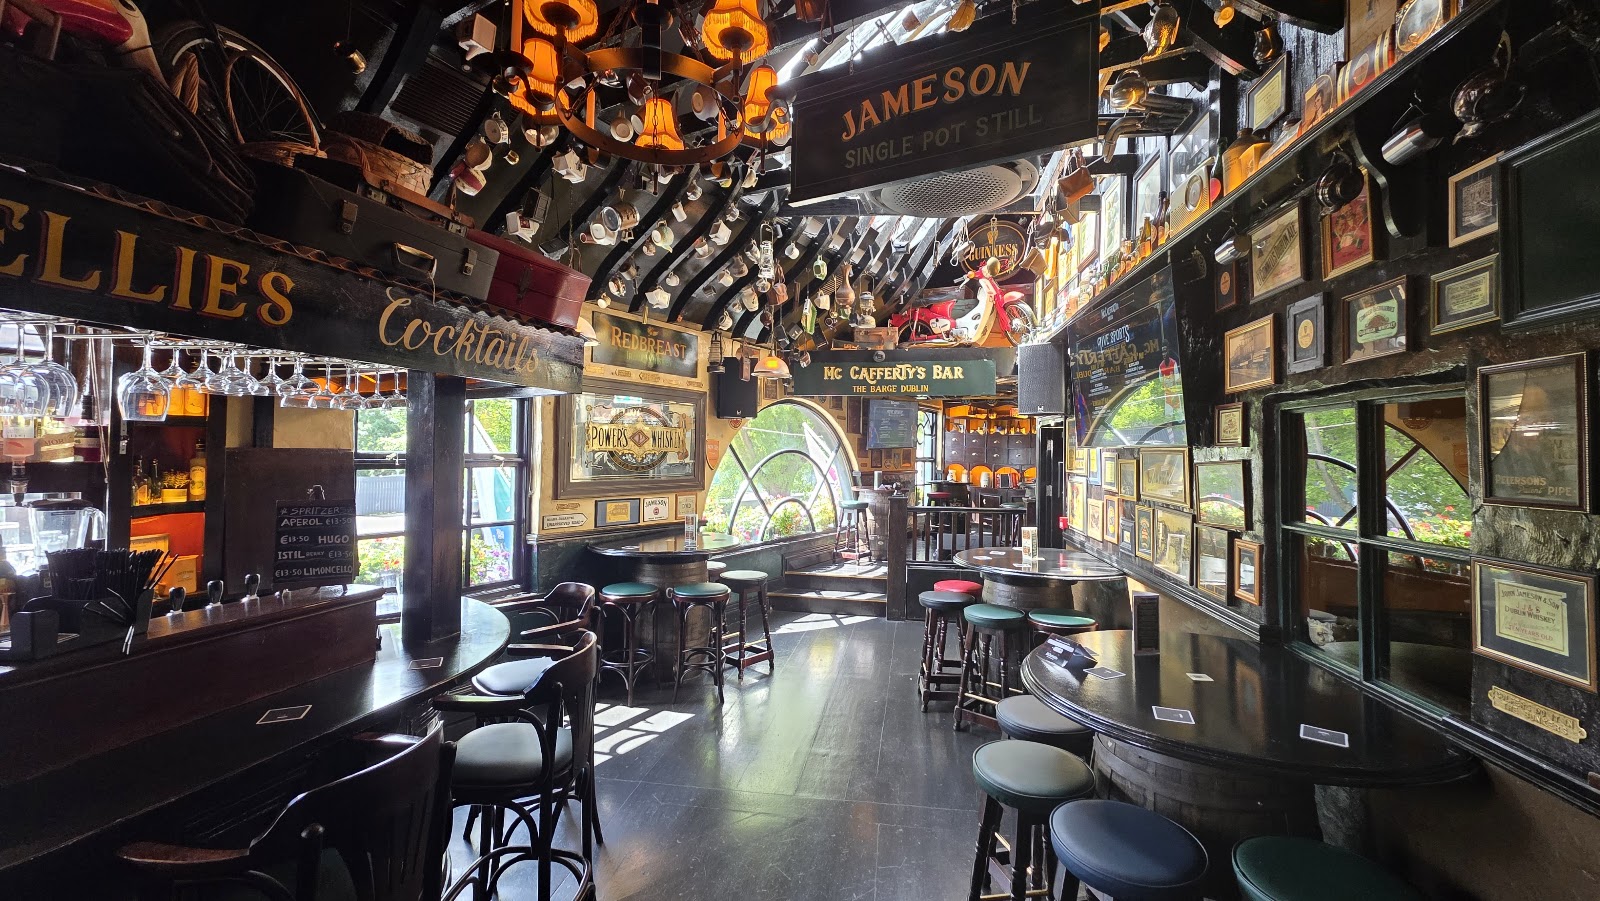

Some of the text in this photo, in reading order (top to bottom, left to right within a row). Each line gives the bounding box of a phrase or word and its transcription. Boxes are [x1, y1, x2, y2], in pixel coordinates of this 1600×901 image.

[841, 61, 1032, 142] JAMESON
[845, 104, 1043, 169] SINGLE POT STILL
[969, 243, 1018, 261] GUINNESS
[378, 286, 540, 374] Cocktails
[1110, 325, 1130, 343] SPORTS
[611, 326, 687, 358] REDBREAST
[850, 364, 926, 384] CAFFERTY'S
[933, 365, 964, 379] BAR
[852, 385, 929, 393] THE BARGE DUBLIN
[591, 426, 629, 448] POWER'S
[651, 430, 681, 449] WHISKEY
[1547, 486, 1573, 496] PIPE
[645, 499, 667, 507] JAMESON
[281, 518, 323, 526] APEROL
[318, 535, 349, 544] HUGO
[277, 551, 305, 559] ISTIL
[303, 565, 353, 576] LIMONCELLO
[1516, 589, 1542, 602] JAMESON
[1546, 598, 1560, 610] SON
[1504, 605, 1526, 616] DUBLIN
[1526, 611, 1556, 624] WHISKEY
[1520, 628, 1540, 637] YEARS
